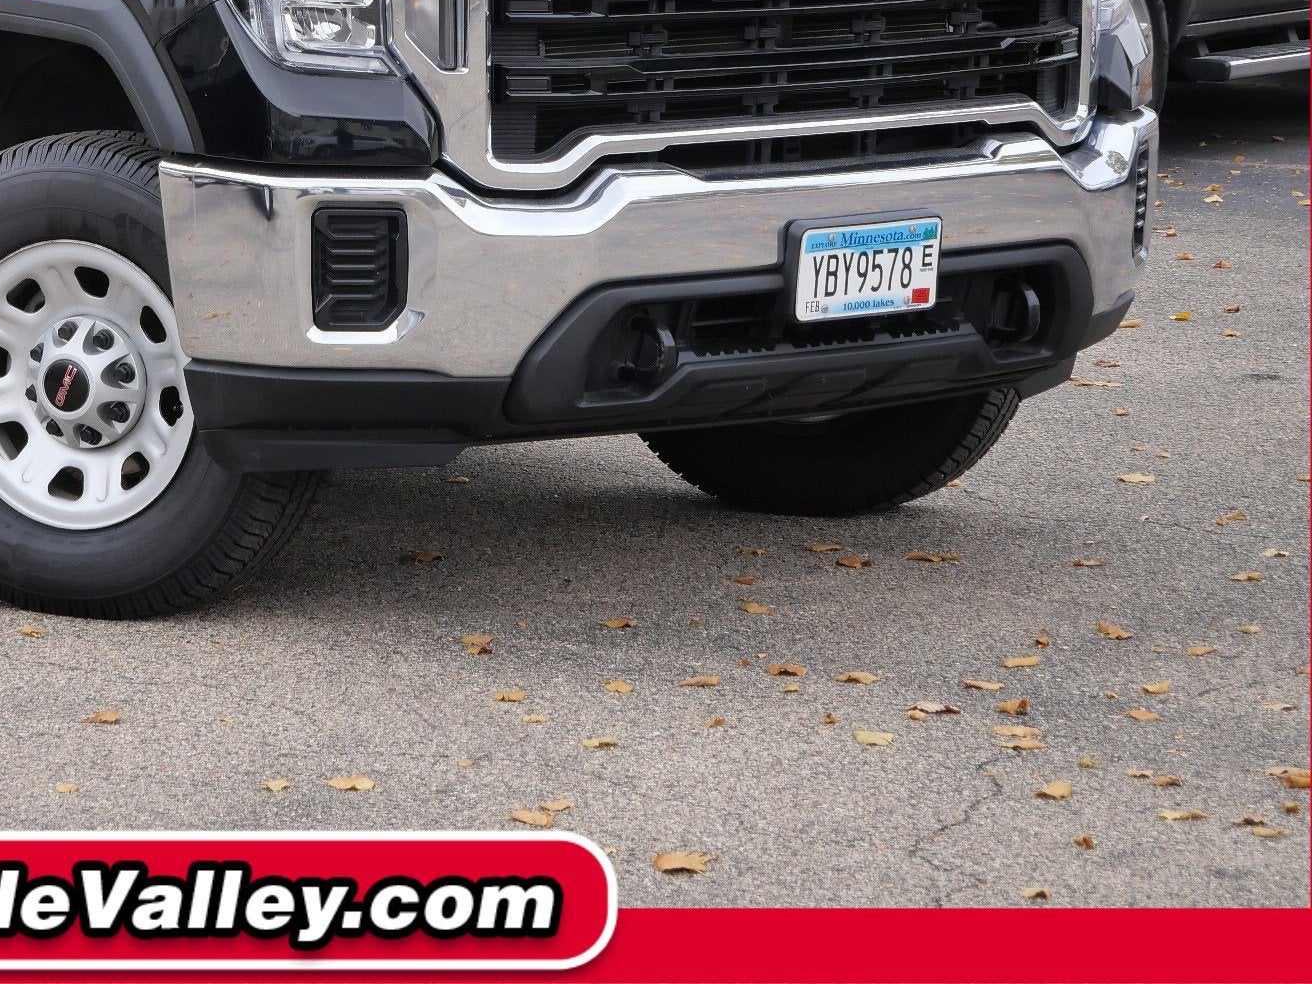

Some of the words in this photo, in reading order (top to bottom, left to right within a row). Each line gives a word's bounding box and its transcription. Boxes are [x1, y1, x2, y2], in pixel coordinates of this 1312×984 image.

[813, 246, 913, 299] YBY9578
[921, 244, 934, 268] E
[805, 301, 820, 314] FEB
[842, 301, 871, 312] 10,000
[873, 298, 895, 309] lakes
[55, 365, 78, 407] GMC
